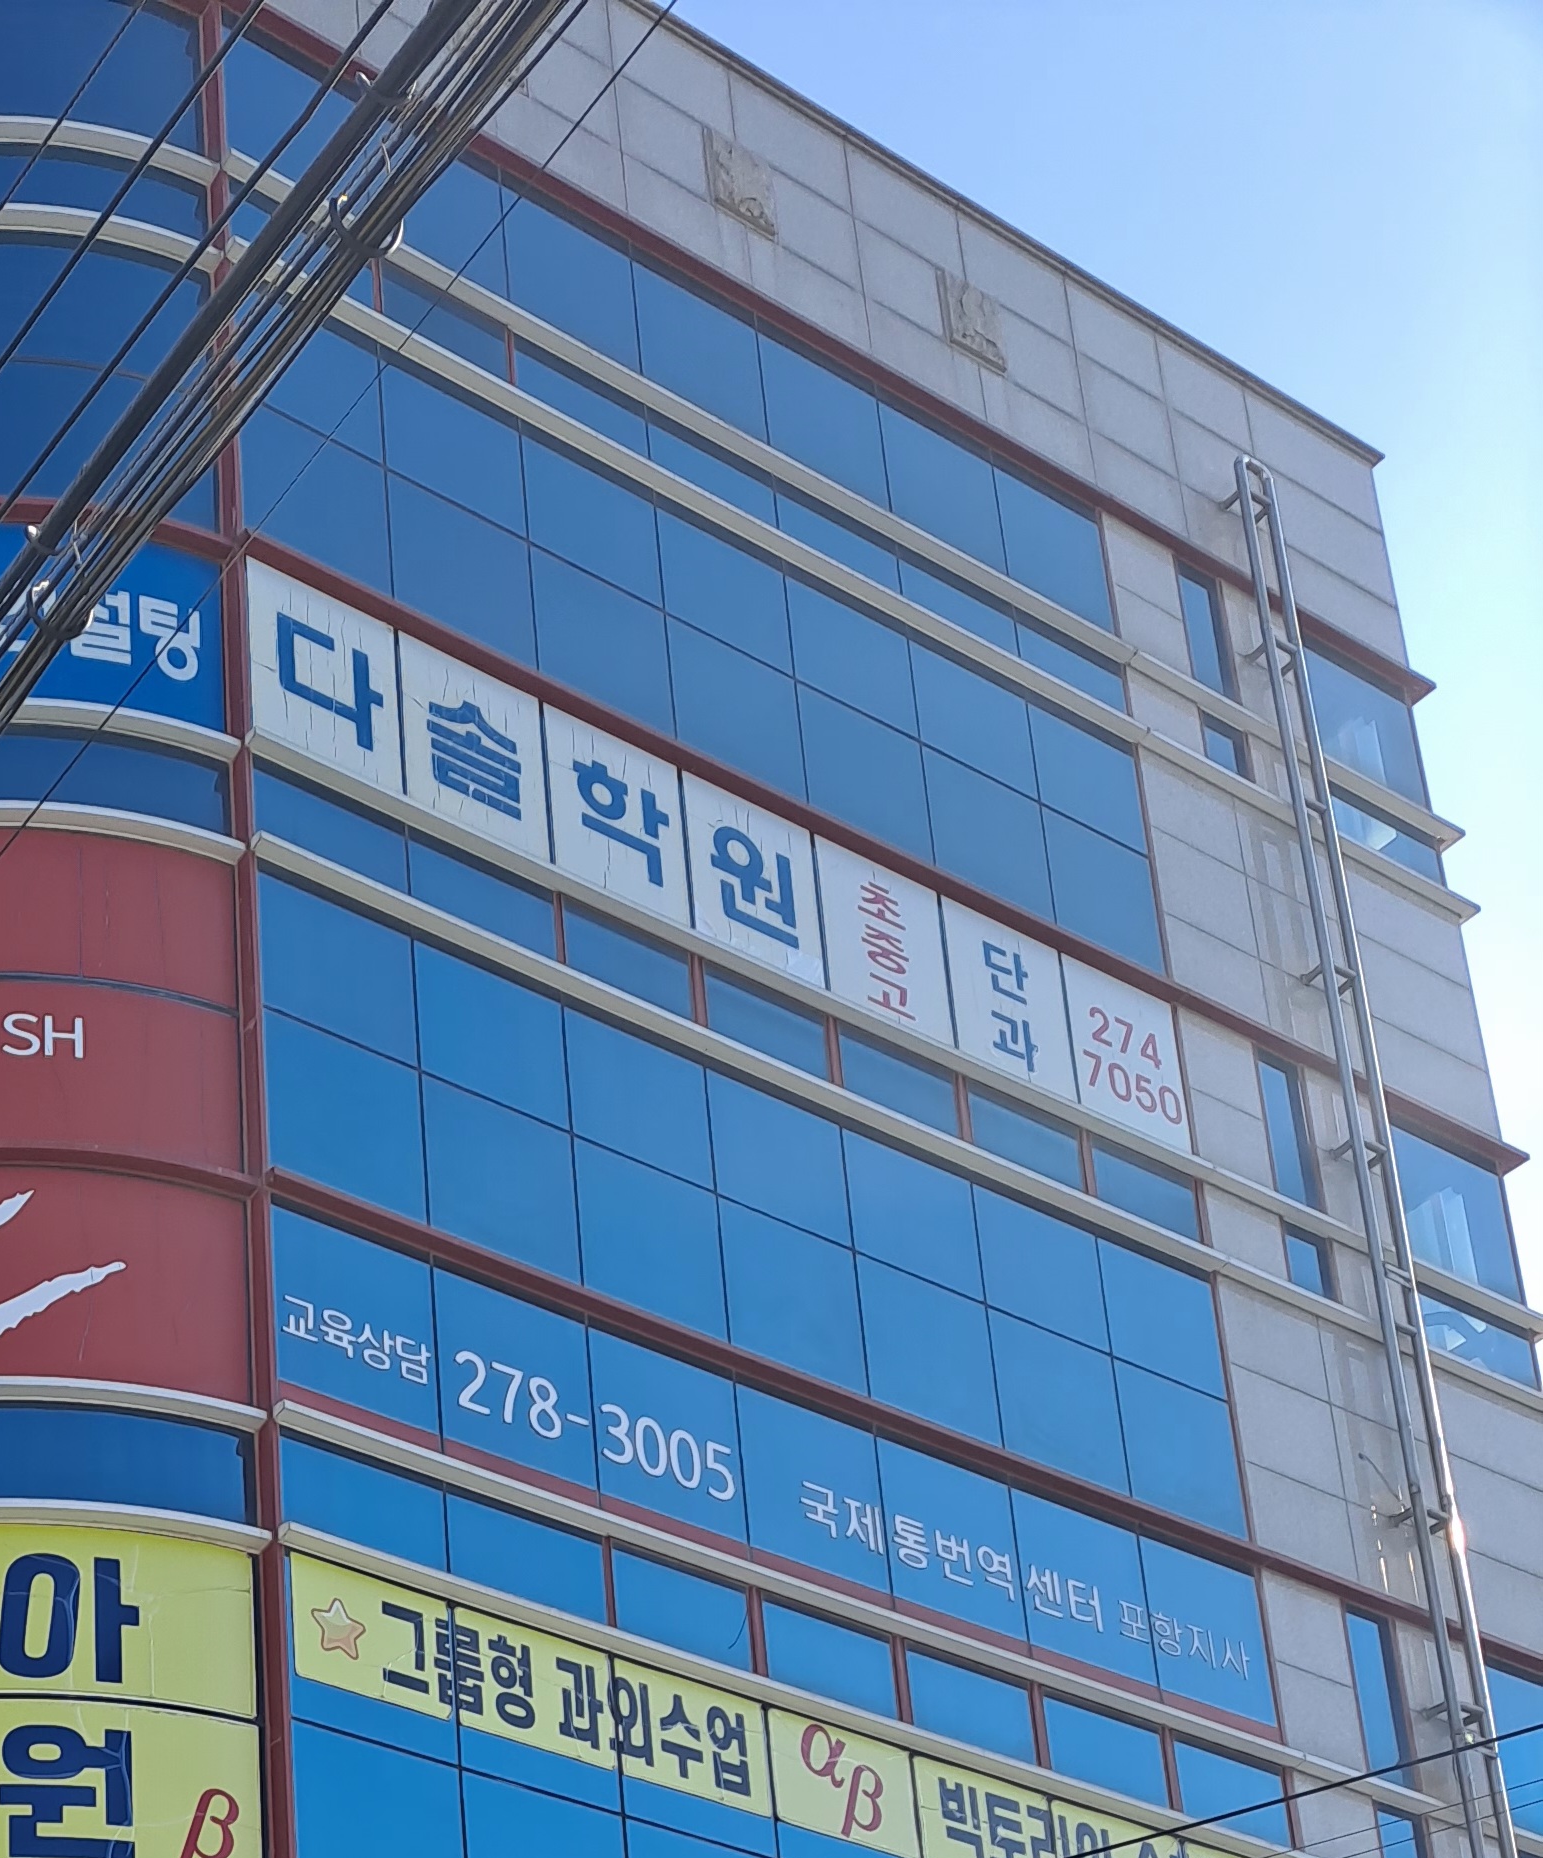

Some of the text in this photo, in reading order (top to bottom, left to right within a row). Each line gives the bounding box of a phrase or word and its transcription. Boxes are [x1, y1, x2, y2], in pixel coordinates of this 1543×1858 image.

[858, 881, 916, 1022] 초중고
[982, 940, 1038, 1073] 단과
[1083, 1049, 1182, 1125] 7050
[1089, 1006, 1162, 1070] 274
[282, 1294, 736, 1502] 교육상담 278-3005
[1117, 1599, 1250, 1681] 포항지사
[556, 1655, 751, 1797] 과외수업
